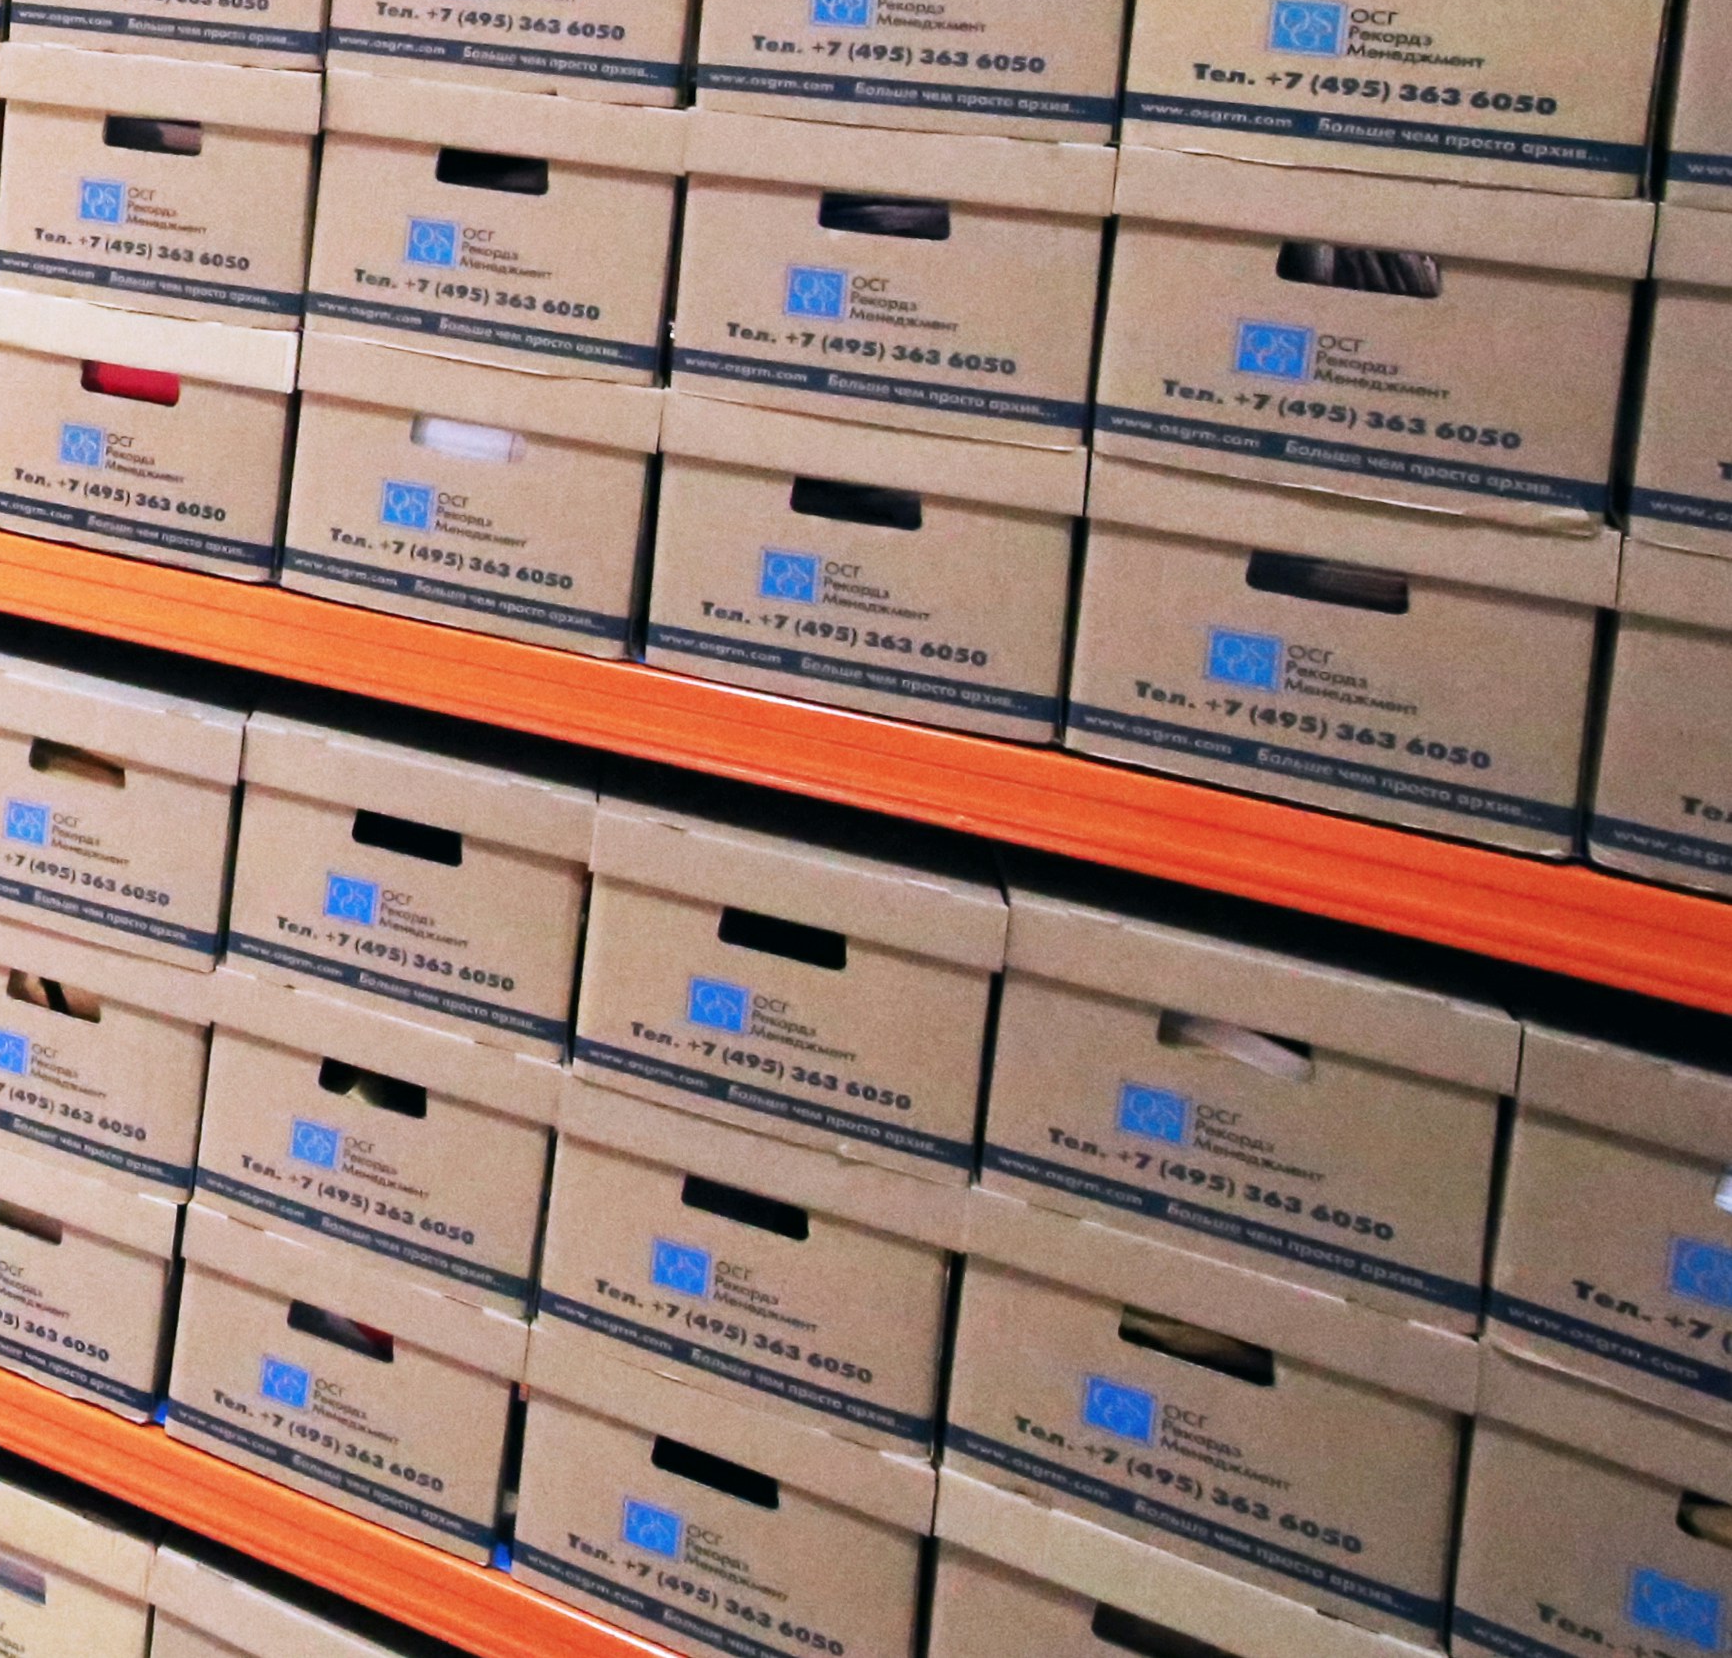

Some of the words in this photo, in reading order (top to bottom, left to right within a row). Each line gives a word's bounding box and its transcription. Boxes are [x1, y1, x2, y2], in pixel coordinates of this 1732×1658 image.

[1348, 25, 1433, 46] Рекордз
[1350, 8, 1399, 26] ОСГ
[1346, 44, 1485, 69] Менеджмент
[1192, 62, 1256, 85] Тел.
[1266, 72, 1304, 90] +7
[1310, 74, 1391, 103] (495)
[1398, 84, 1462, 106] 363
[1470, 91, 1558, 116] 6050
[1400, 130, 1439, 143] чем
[1445, 134, 1516, 152] просто
[726, 321, 777, 343] Тел.
[785, 331, 815, 348] +7
[821, 334, 885, 362] (495)
[891, 345, 941, 365] 363
[947, 352, 1017, 375] 6050
[276, 915, 318, 939] Тел.
[325, 930, 350, 948] +7
[354, 936, 407, 967] (495)
[412, 953, 453, 976] 363
[458, 966, 515, 993] 6050
[1047, 1126, 1107, 1159] Тел.
[1117, 1148, 1153, 1172] +7
[1159, 1158, 1235, 1200] (495)
[1243, 1183, 1302, 1215] 363
[1310, 1203, 1394, 1242] 6050
